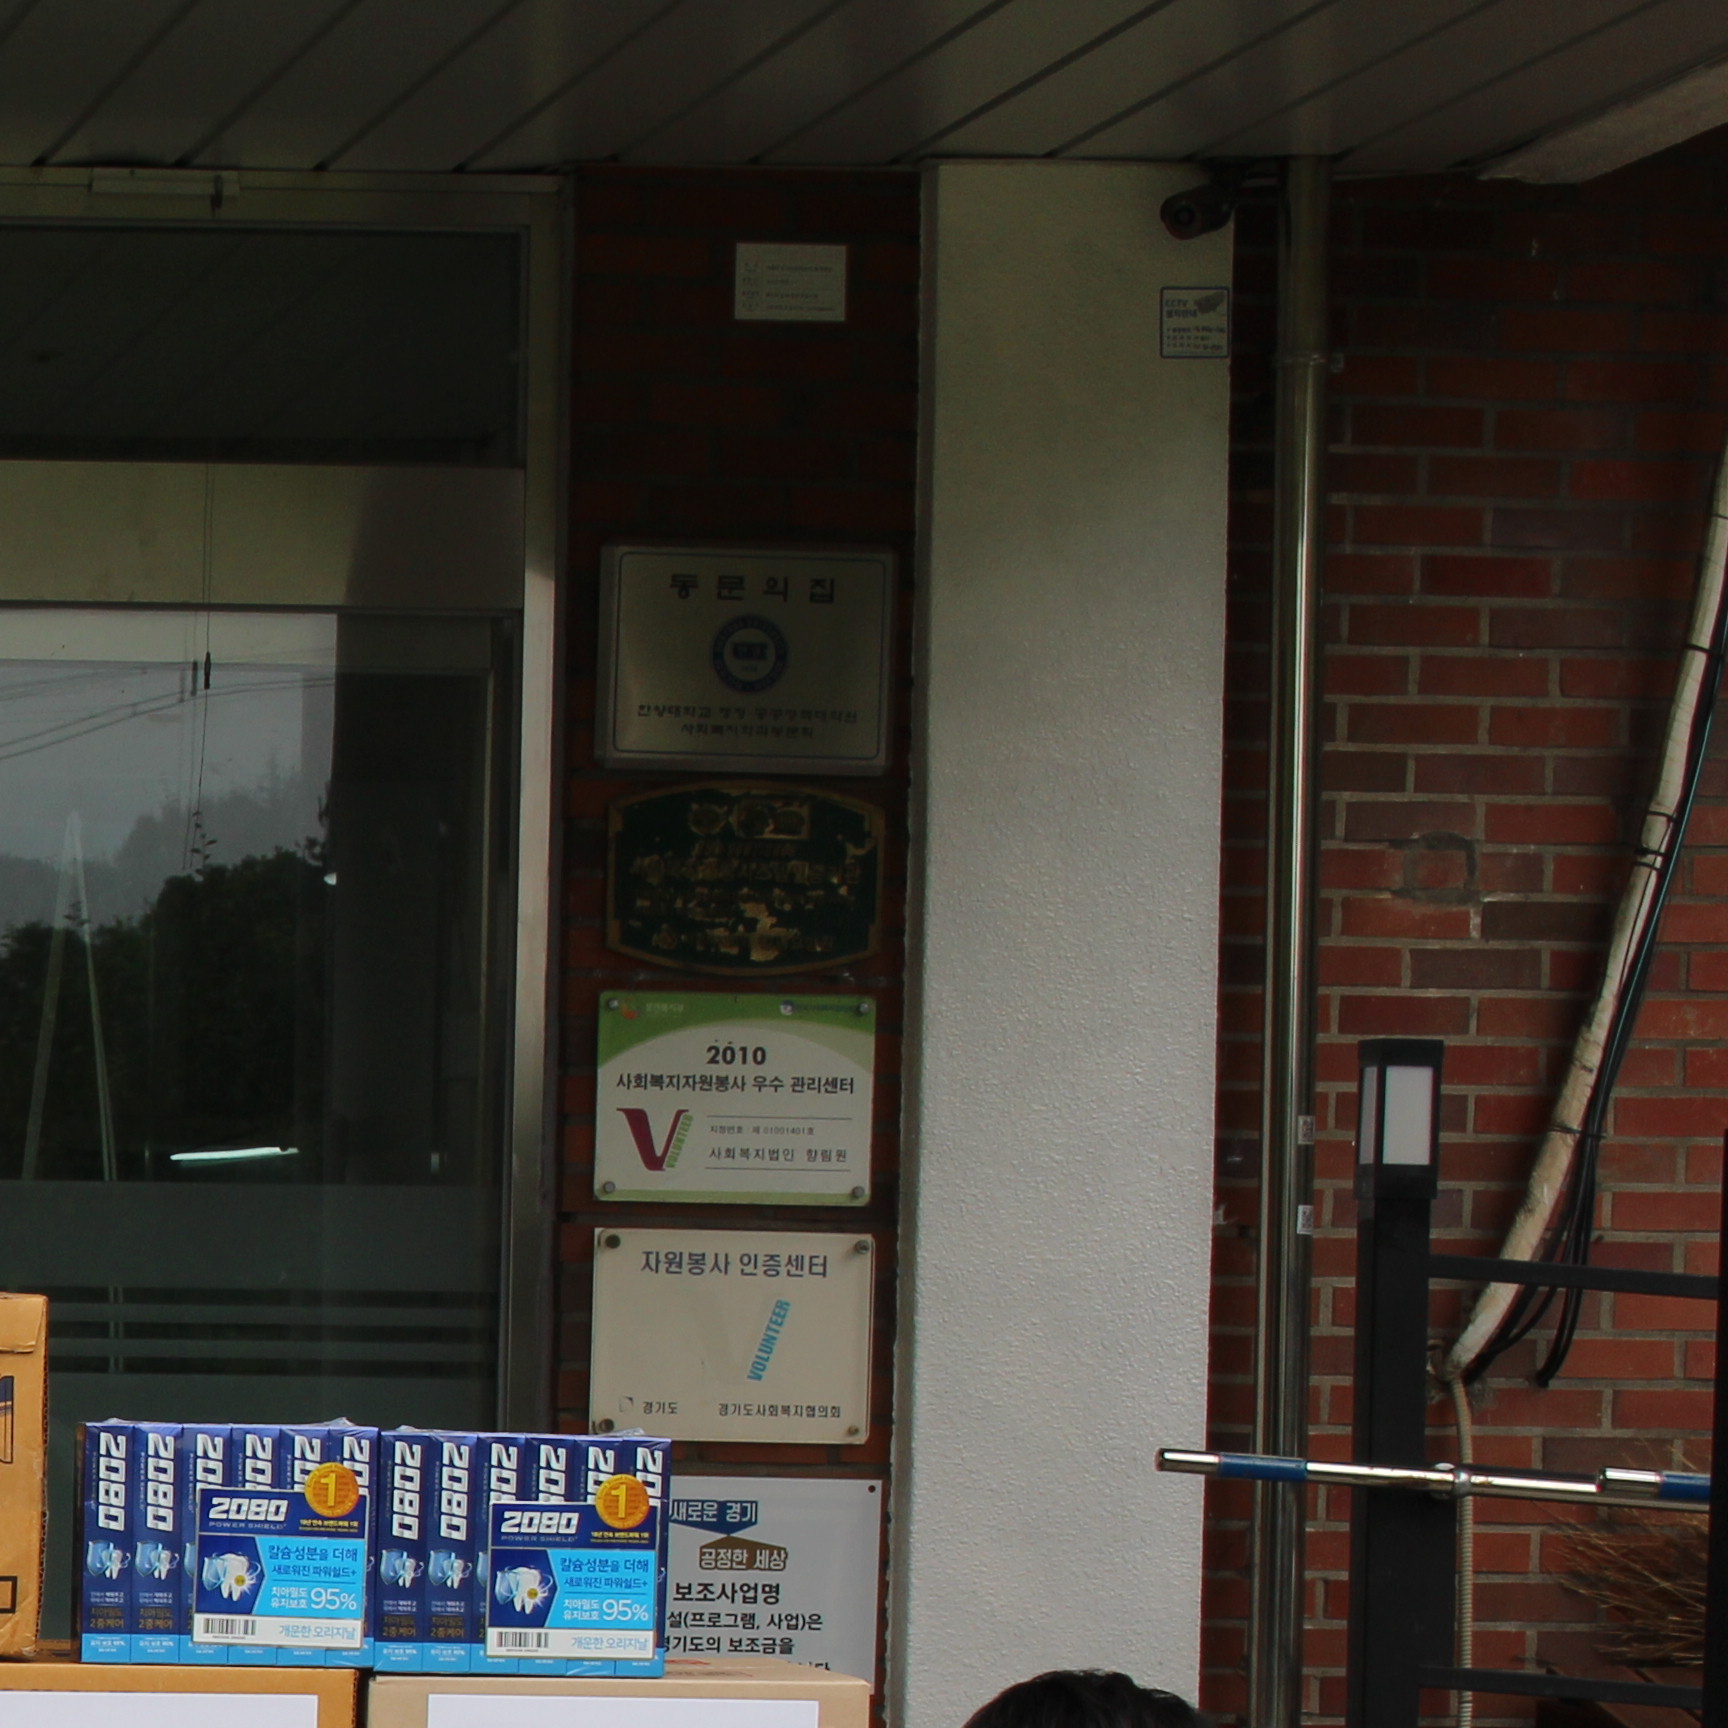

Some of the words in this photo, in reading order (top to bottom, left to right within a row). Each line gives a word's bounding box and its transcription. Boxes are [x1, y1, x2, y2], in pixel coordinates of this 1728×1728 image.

[1166, 299, 1189, 308] CCTV
[706, 1046, 766, 1065] 2010
[616, 1073, 746, 1092] 사회복지자원봉사
[752, 1075, 784, 1093] 우수
[790, 1076, 855, 1094] 관리센터
[709, 1147, 795, 1161] 사회복지법인
[806, 1148, 848, 1163] 향림원
[641, 1250, 731, 1275] 자원봉사
[739, 1252, 828, 1278] 인증센터
[747, 1299, 791, 1381] VOLUNTEER
[642, 1400, 679, 1414] 경기도
[718, 1402, 841, 1418] 경기도사회복지협의회
[98, 1432, 126, 1532] 2080
[146, 1432, 175, 1533] 2080
[320, 1472, 336, 1507] 1
[392, 1441, 422, 1541] 2080
[440, 1441, 470, 1541] 2080
[209, 1497, 289, 1522] 2080
[611, 1484, 627, 1519] 1
[669, 1501, 718, 1522] 새로운
[726, 1502, 757, 1523] 경기
[501, 1511, 580, 1535] 2080
[332, 1547, 357, 1562] 더해
[701, 1548, 748, 1569] 공정한
[753, 1549, 786, 1570] 세상
[272, 1564, 310, 1576] 새로워진
[271, 1587, 309, 1599] 치아밀도
[271, 1598, 309, 1610] 유지보호
[310, 1587, 357, 1610] 95%
[673, 1581, 781, 1605] 보조사업명
[602, 1600, 649, 1622] 95%
[766, 1613, 823, 1631] 사업)은
[279, 1624, 313, 1639] 개운한
[727, 1637, 795, 1655] 보조금을
